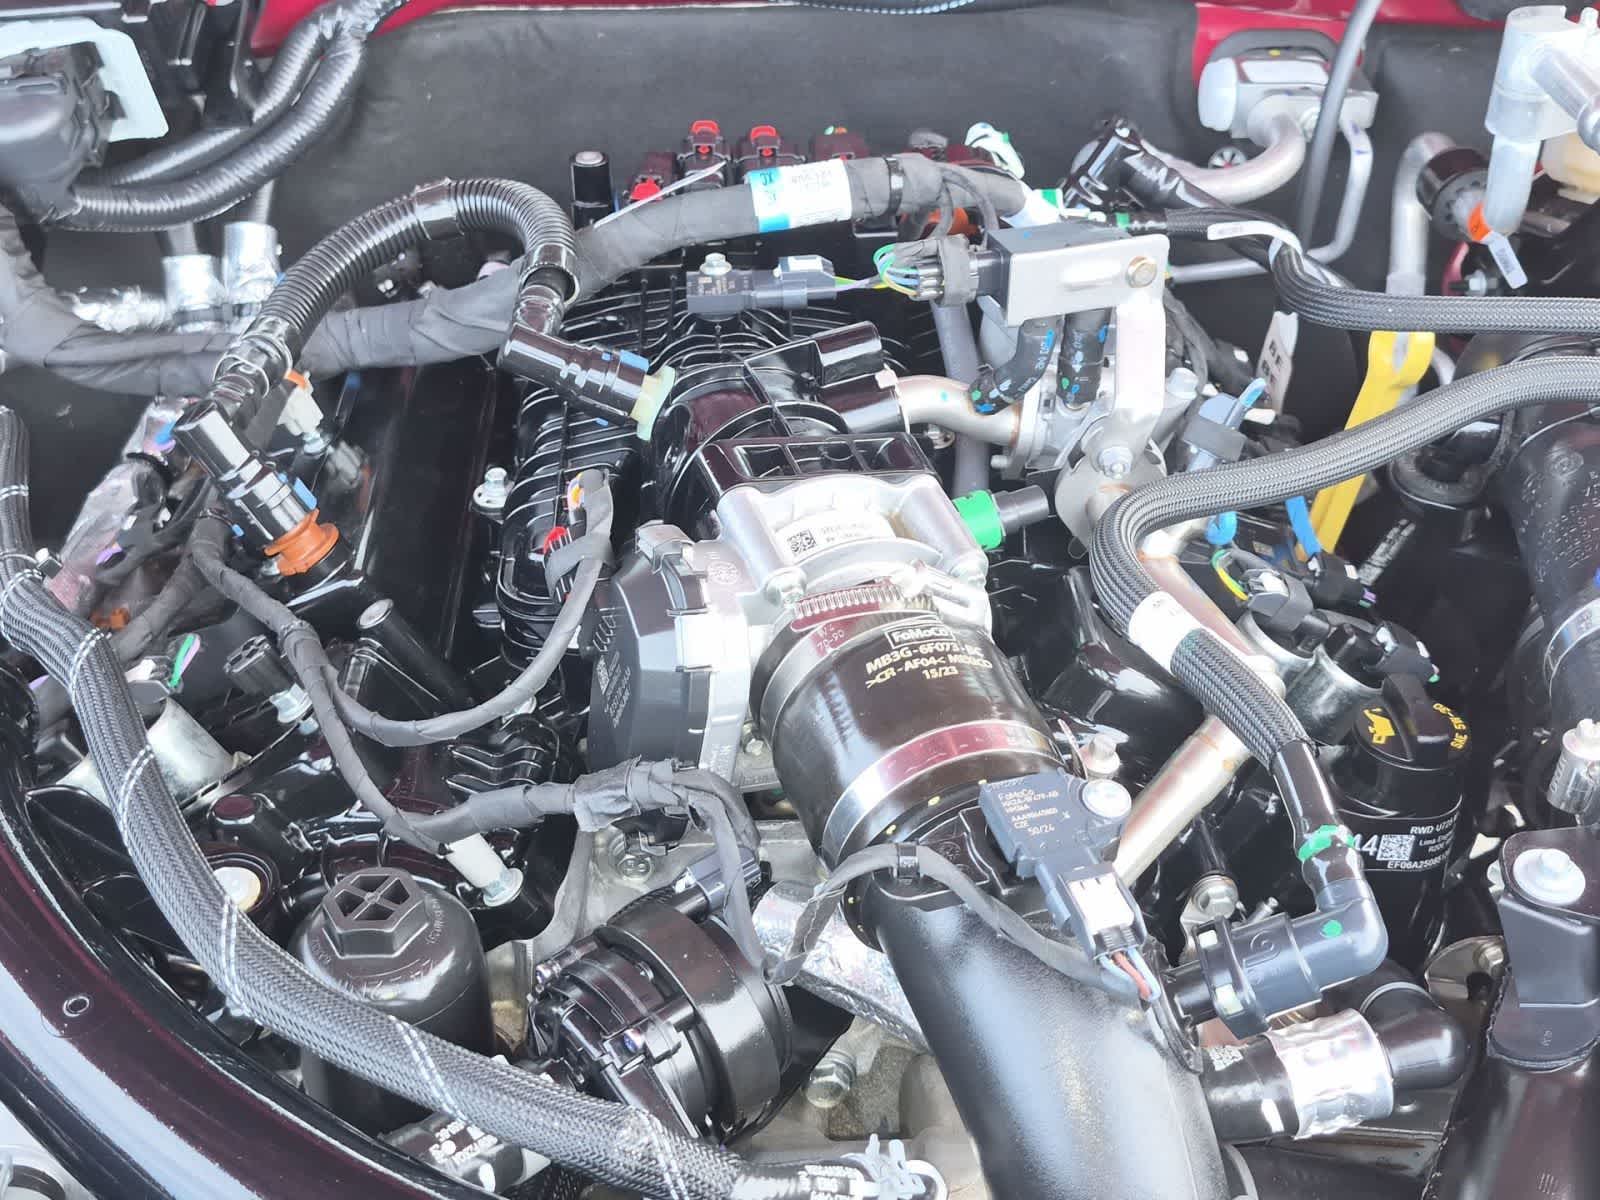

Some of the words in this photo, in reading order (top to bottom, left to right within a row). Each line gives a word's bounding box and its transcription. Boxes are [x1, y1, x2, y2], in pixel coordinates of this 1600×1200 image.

[892, 627, 950, 644] FoMoCo
[922, 665, 960, 680] 15/23
[1410, 825, 1434, 834] RWD
